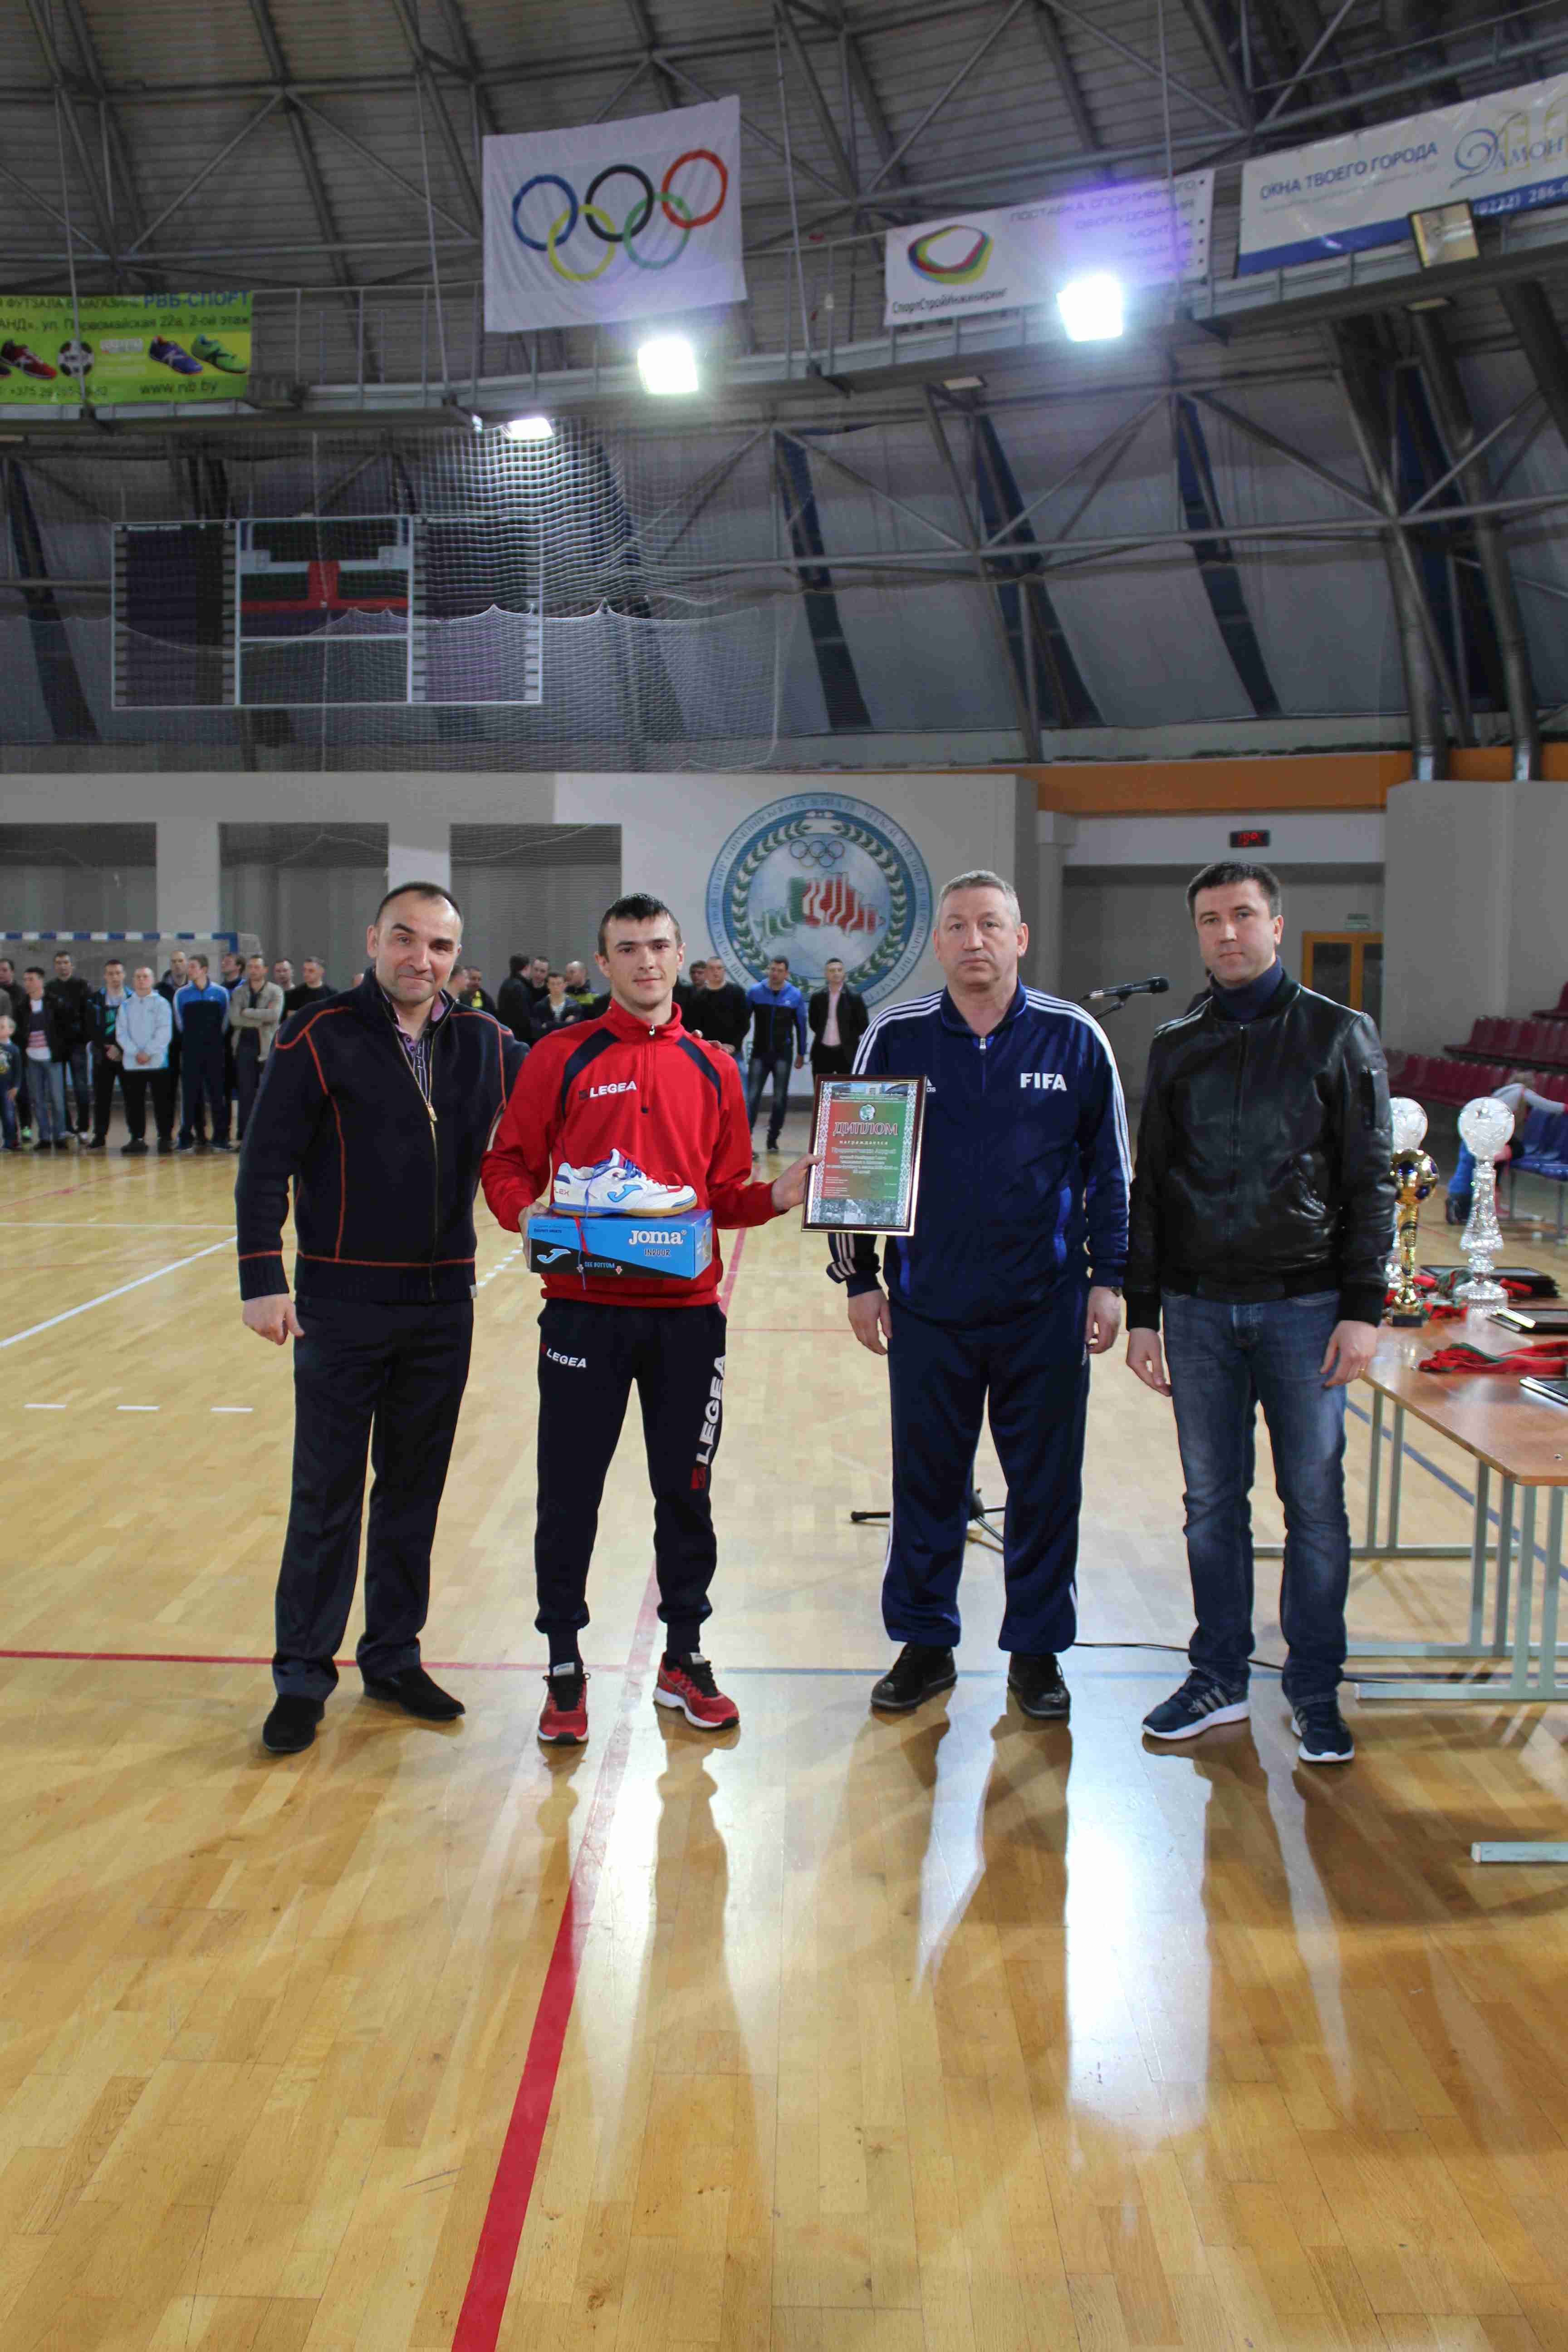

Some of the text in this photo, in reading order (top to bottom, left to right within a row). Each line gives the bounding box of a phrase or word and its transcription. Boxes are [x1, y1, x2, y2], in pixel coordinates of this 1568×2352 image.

[1260, 178, 1301, 200] ОКНА
[1305, 161, 1367, 189] ТВОЕГО
[1371, 141, 1439, 172] ГОРОДА
[144, 290, 249, 309] РВБ-СПОРТ
[590, 1080, 637, 1098] LEGEA
[1020, 1072, 1067, 1091] FIFA
[833, 1122, 898, 1136] ДИПЛОМ
[546, 1348, 587, 1368] LEGEA
[696, 1354, 726, 1465] LEGEA
